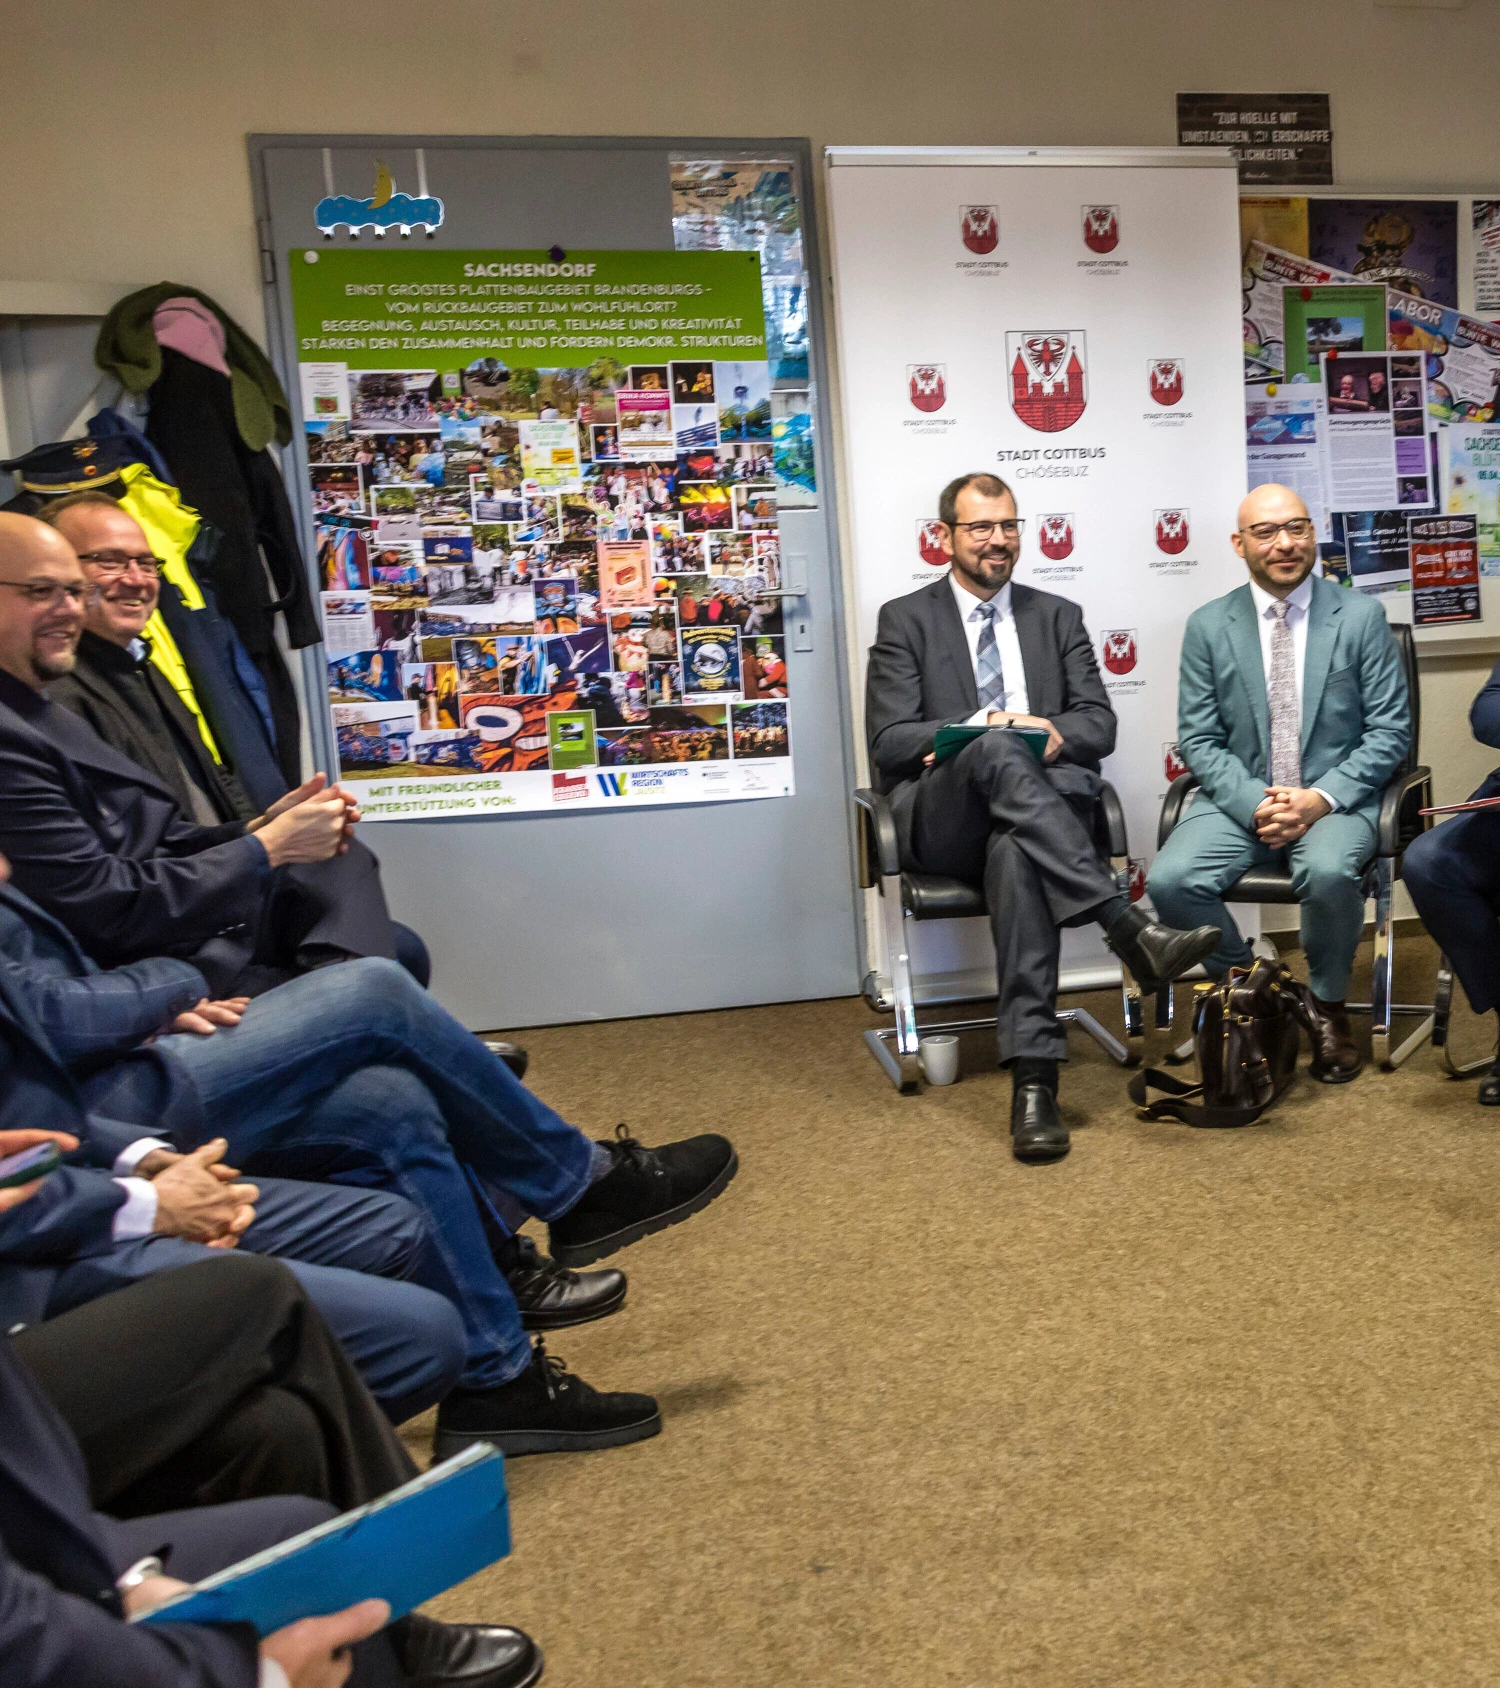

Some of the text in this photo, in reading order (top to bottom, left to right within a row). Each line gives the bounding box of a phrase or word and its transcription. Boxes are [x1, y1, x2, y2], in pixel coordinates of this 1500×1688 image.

[1239, 111, 1278, 124] HOELLE
[1279, 111, 1298, 124] MIT
[1271, 129, 1331, 142] ERSCHAFFE
[463, 262, 598, 278] SACHSENDORF
[345, 283, 385, 297] EINST
[459, 283, 591, 297] PLATTENBAUGEBIET
[593, 282, 702, 296] BRANDENBURGS
[385, 300, 679, 314] VOM RÜCKBAUGEBIET ZUM WOHLFÜHLORT?
[321, 315, 743, 333] BEGEGNUNG, AUSTAUSCH, KULTUR, TEILHABE UND KREATIVITÄT
[301, 334, 764, 350] STÄRKEN DEN ZUSAMMENHALT UND FÖRDERN DEMOKR. STRUKTUREN
[997, 446, 1107, 462] STADT COTTBUS
[1015, 464, 1090, 480] CHÓŚEBUZ
[630, 768, 690, 780] WIRTSCHAFTS
[368, 779, 502, 798] MIT FREUNDLICHER
[631, 778, 664, 788] REGION
[481, 795, 517, 807] VON:
